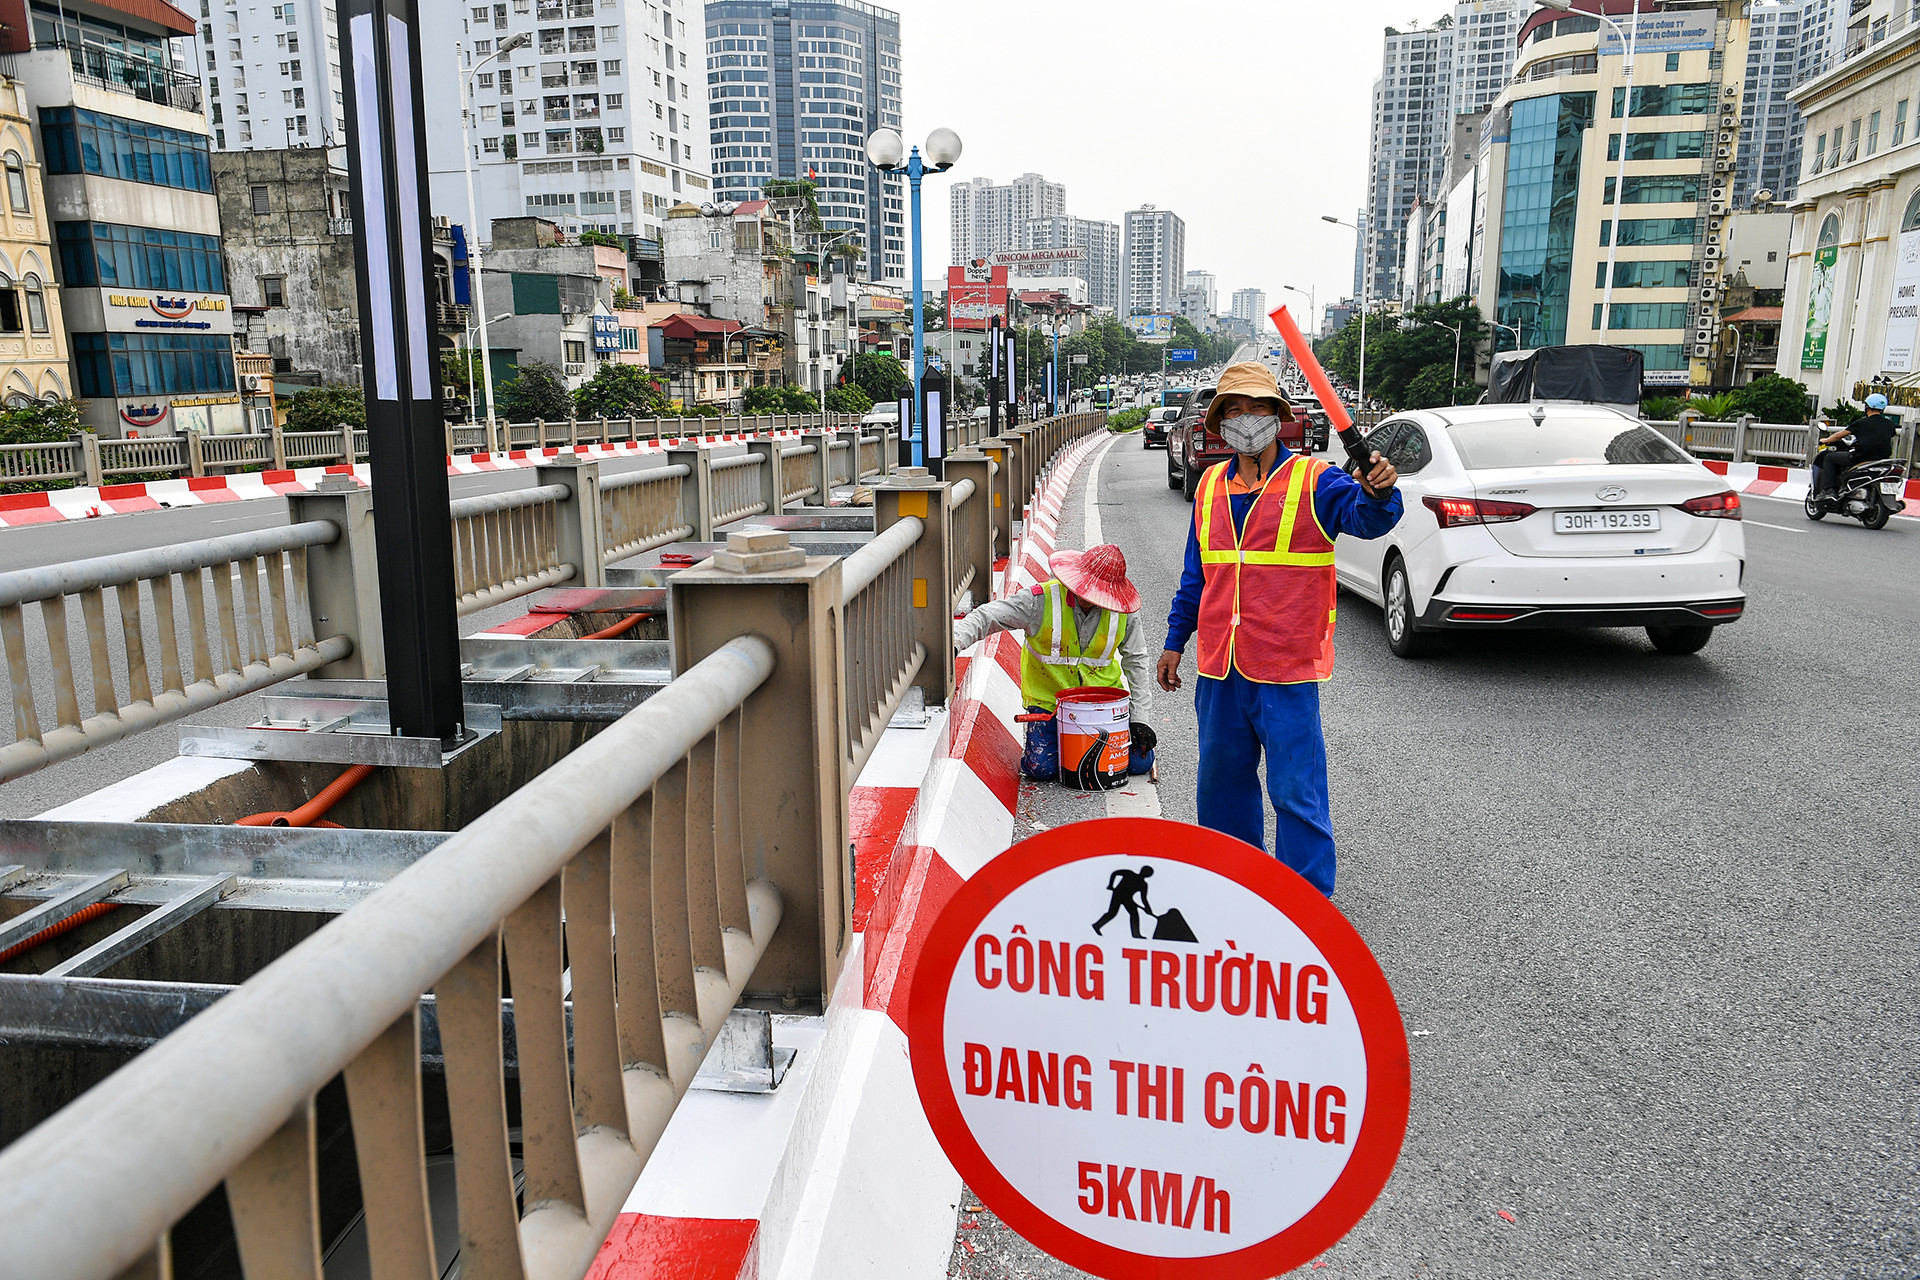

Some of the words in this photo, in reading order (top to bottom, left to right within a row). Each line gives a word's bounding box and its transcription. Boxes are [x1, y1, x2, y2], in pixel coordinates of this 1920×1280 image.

[1655, 20, 1675, 29] CÔNG
[1676, 20, 1685, 28] TY
[1661, 29, 1680, 39] CÔNG
[1681, 28, 1707, 38] NGHIỆP
[995, 252, 1030, 263] VINCOM
[1031, 251, 1054, 261] MEGA
[1056, 249, 1080, 259] MALL
[967, 267, 989, 275] Doppel
[1018, 263, 1035, 271] TIMES
[971, 272, 985, 280] herz
[1897, 284, 1916, 299] HOMIE
[110, 294, 127, 306] NHA
[127, 296, 149, 308] KHOA
[195, 296, 214, 311] THẨM
[1889, 304, 1919, 319] PRESCHOOL
[1564, 513, 1651, 529] 30H-192.99
[974, 925, 1104, 1001] CÔNG
[1122, 939, 1329, 1025] TRƯỜNG
[963, 1042, 1092, 1111] ĐANG
[1109, 1059, 1184, 1124] THI
[1203, 1063, 1347, 1145] CÔNG
[1077, 1160, 1231, 1234] 5KM/h
